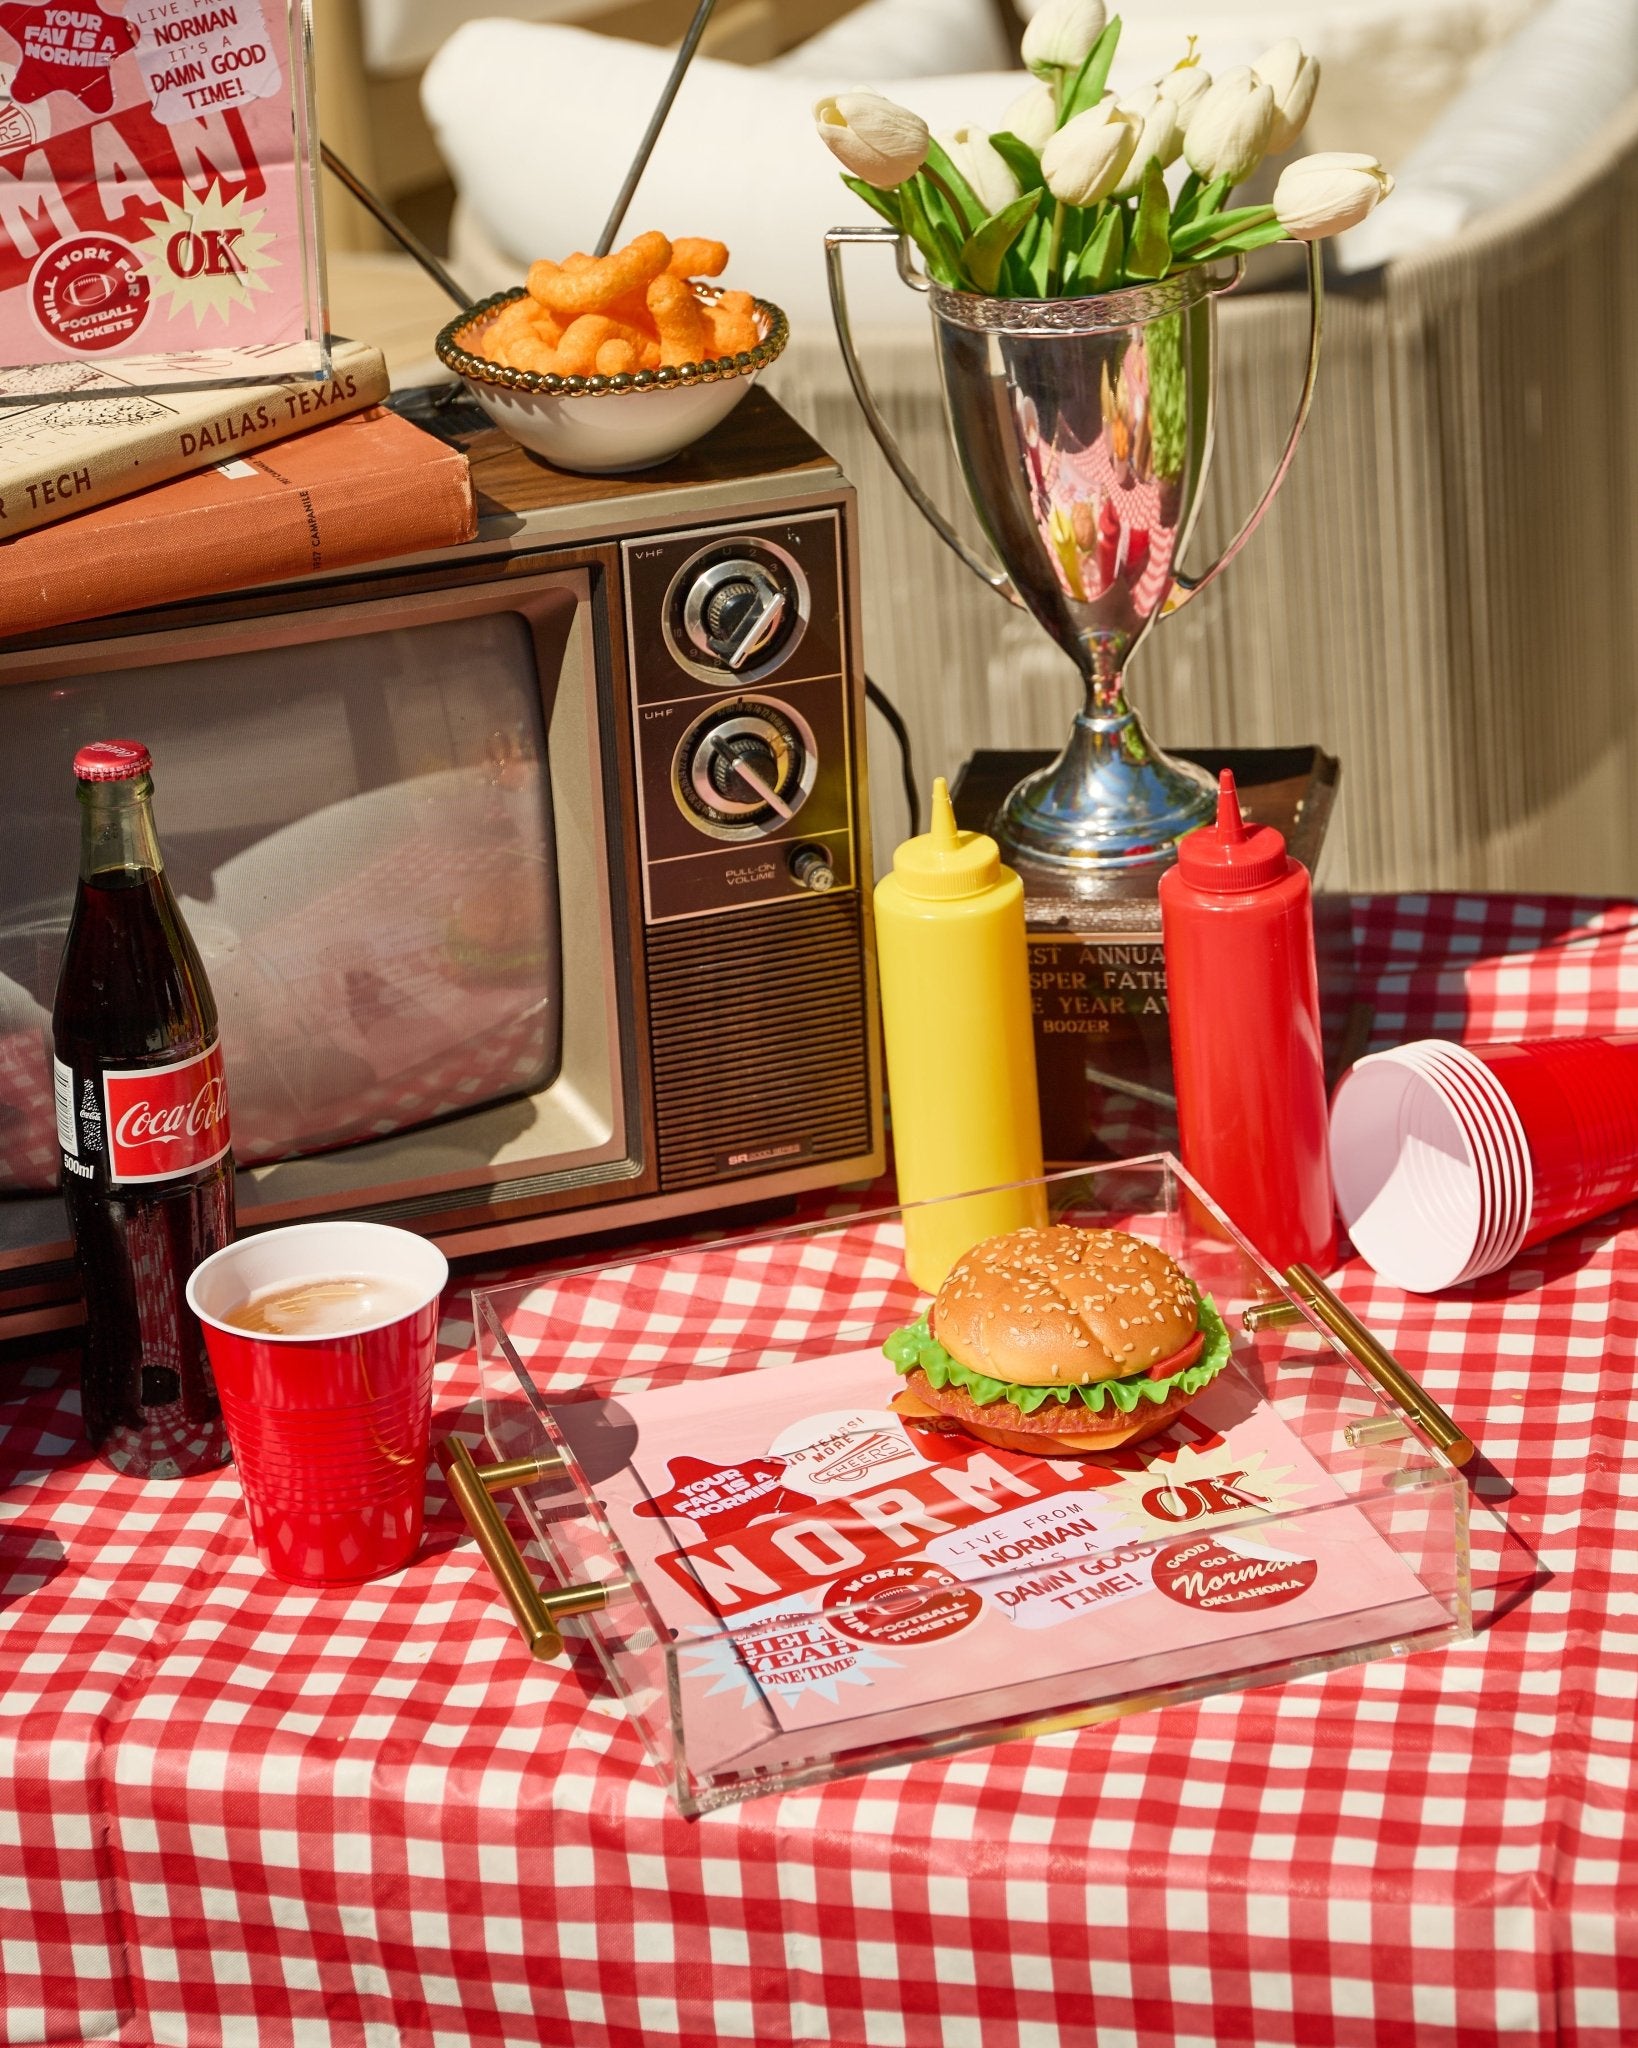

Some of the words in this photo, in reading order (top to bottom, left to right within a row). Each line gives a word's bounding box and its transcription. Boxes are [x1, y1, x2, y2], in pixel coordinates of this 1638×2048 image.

[44, 10, 103, 32] YOUR
[137, 2, 180, 24] LIVE
[153, 6, 238, 47] NORMAN
[24, 26, 68, 46] FAV
[72, 30, 97, 49] IS
[101, 36, 116, 51] A
[168, 42, 208, 63] IT'S
[222, 35, 232, 48] A
[24, 41, 112, 67] NORMIE
[150, 60, 206, 93] DAMN
[211, 44, 266, 75] GOOD
[182, 77, 245, 110] TIME!
[167, 228, 248, 279] OK
[43, 276, 61, 324] WILL
[55, 247, 113, 271] WORK
[115, 258, 140, 297] FOR
[59, 304, 138, 332] FOOTBALL
[70, 319, 134, 343] TICKETS
[25, 467, 91, 509] TECH
[180, 405, 277, 457] DALLAS,
[285, 375, 358, 419] TEXAS
[300, 490, 321, 547] CAMPANILE
[635, 548, 663, 560] VHF
[644, 709, 673, 720] UHF
[726, 863, 776, 878] PULL-ON
[727, 871, 776, 885] VOLUME
[1059, 996, 1126, 1014] YEAR
[1043, 1019, 1110, 1034] BOOZER
[115, 1069, 227, 1148] Coca-Cola
[64, 1153, 95, 1180] 500ml
[812, 1434, 855, 1463] MORE
[826, 1442, 899, 1479] CHEERS
[673, 1489, 721, 1513] FAV
[721, 1477, 751, 1495] IS
[753, 1471, 772, 1483] A
[677, 1469, 744, 1497] YOUR
[1142, 1471, 1272, 1522] OK
[686, 1477, 781, 1520] NORMIE
[675, 1440, 1110, 1606] NORM
[949, 1529, 1008, 1556] LIVE
[1023, 1503, 1083, 1529] FROM
[978, 1518, 1098, 1568] NORMAN
[1084, 1541, 1099, 1552] A
[1166, 1542, 1210, 1569] GOOD
[994, 1570, 1076, 1607] DAMN
[1079, 1539, 1157, 1576] GOOD
[1200, 1556, 1227, 1568] GO
[844, 1567, 914, 1592] WORK
[1050, 1572, 1143, 1610] TIME!
[1200, 1579, 1305, 1607] OKLAHOMA
[869, 1602, 969, 1637] FOOTBALL
[888, 1611, 969, 1642] TICKETS
[734, 1639, 864, 1675] YEAH
